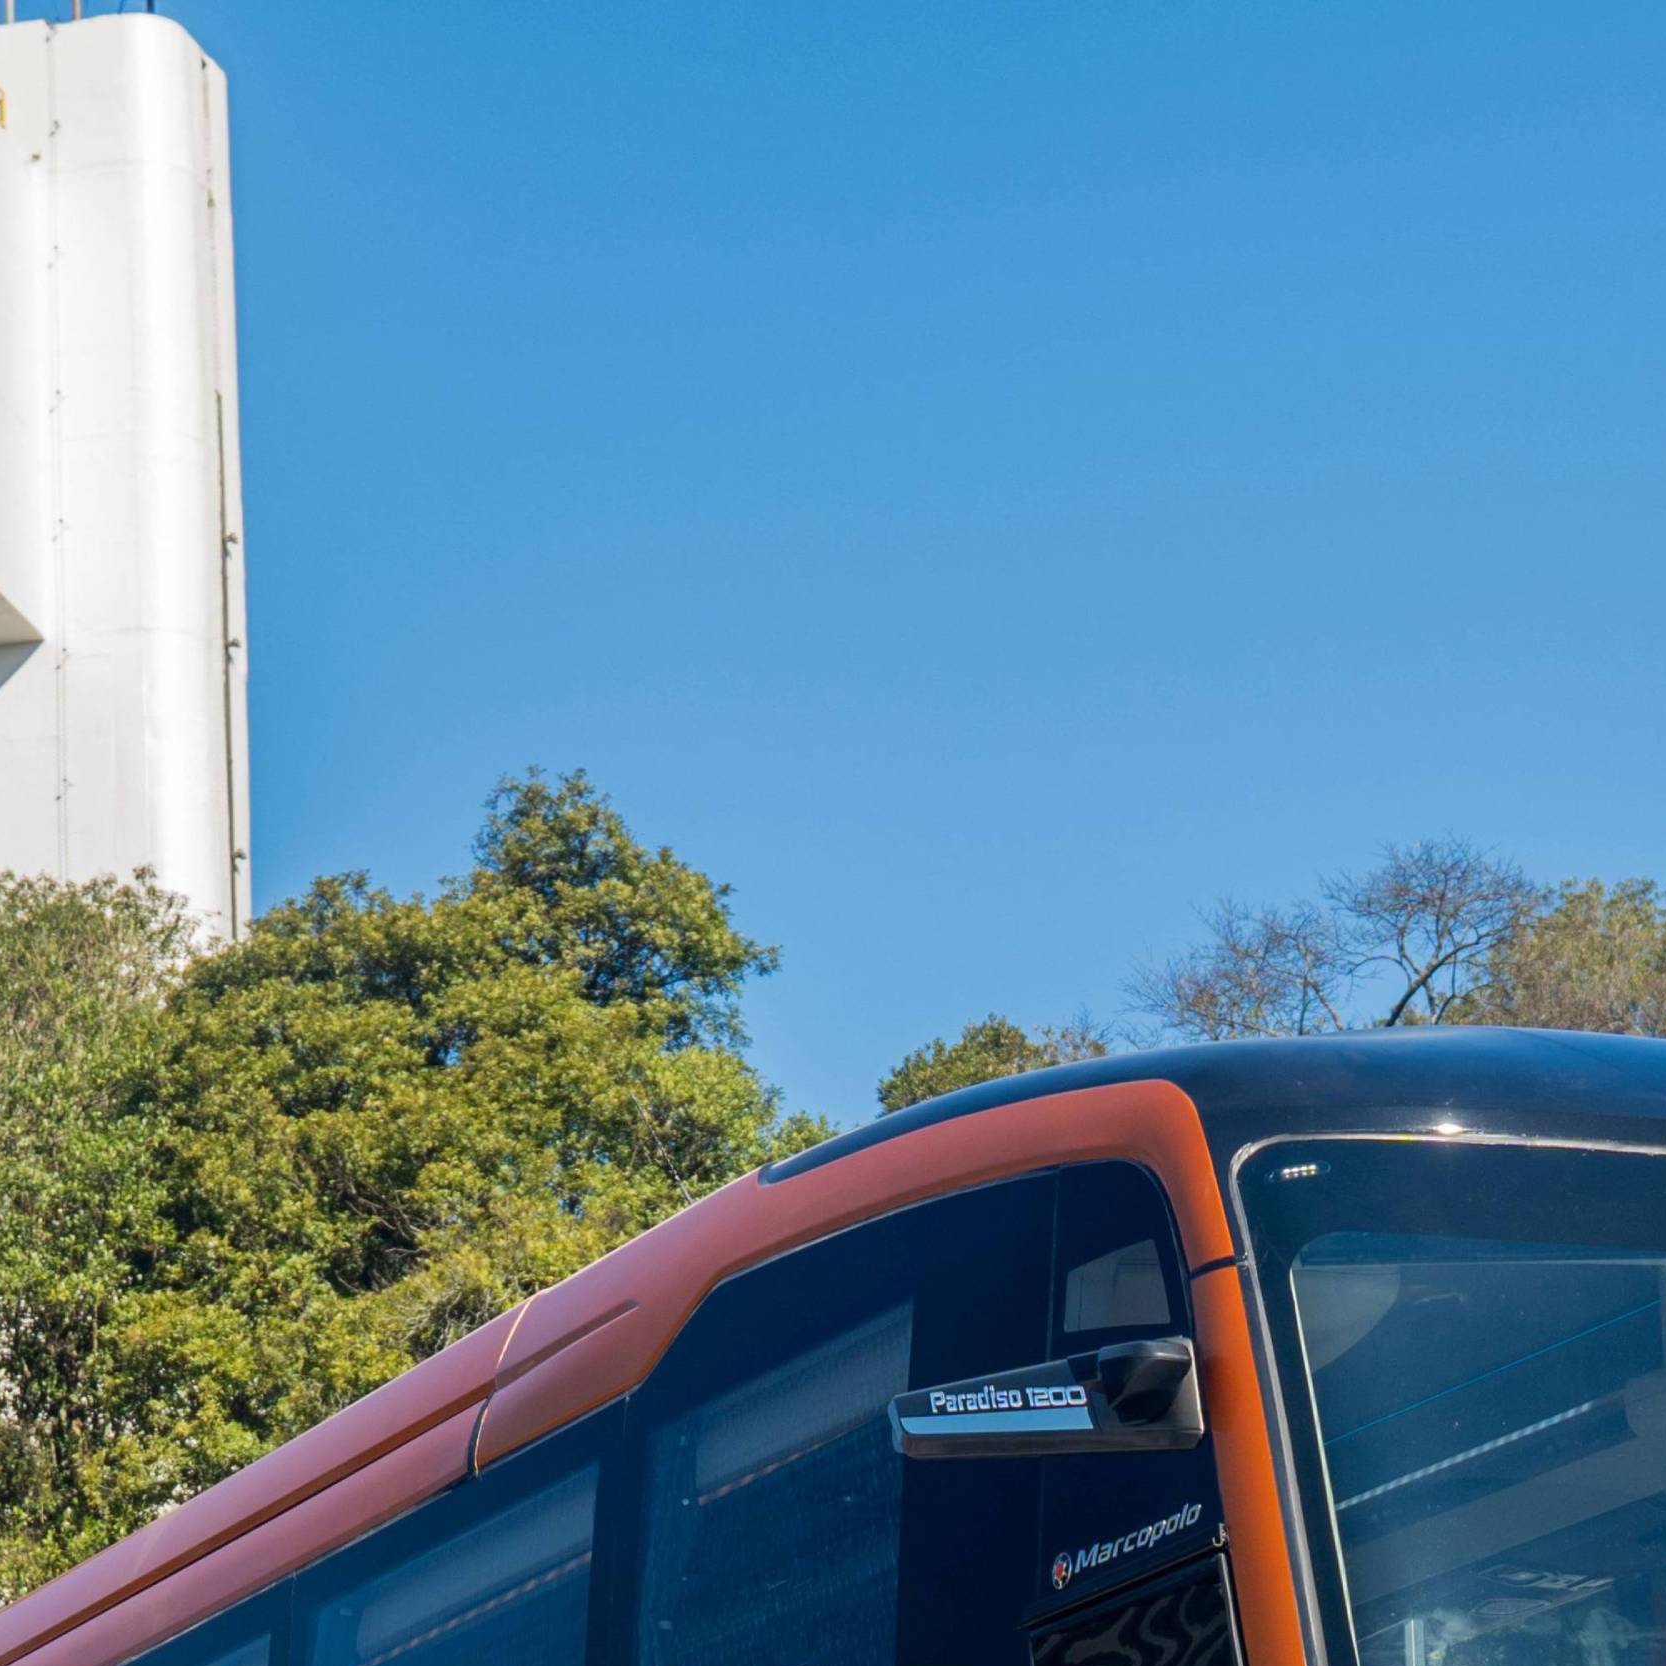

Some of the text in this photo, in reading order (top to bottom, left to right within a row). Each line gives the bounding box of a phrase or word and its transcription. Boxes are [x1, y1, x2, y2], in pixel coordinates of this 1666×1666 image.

[930, 1385, 1088, 1413] Paradiso 1200
[1074, 1503, 1202, 1573] Marcopolo
